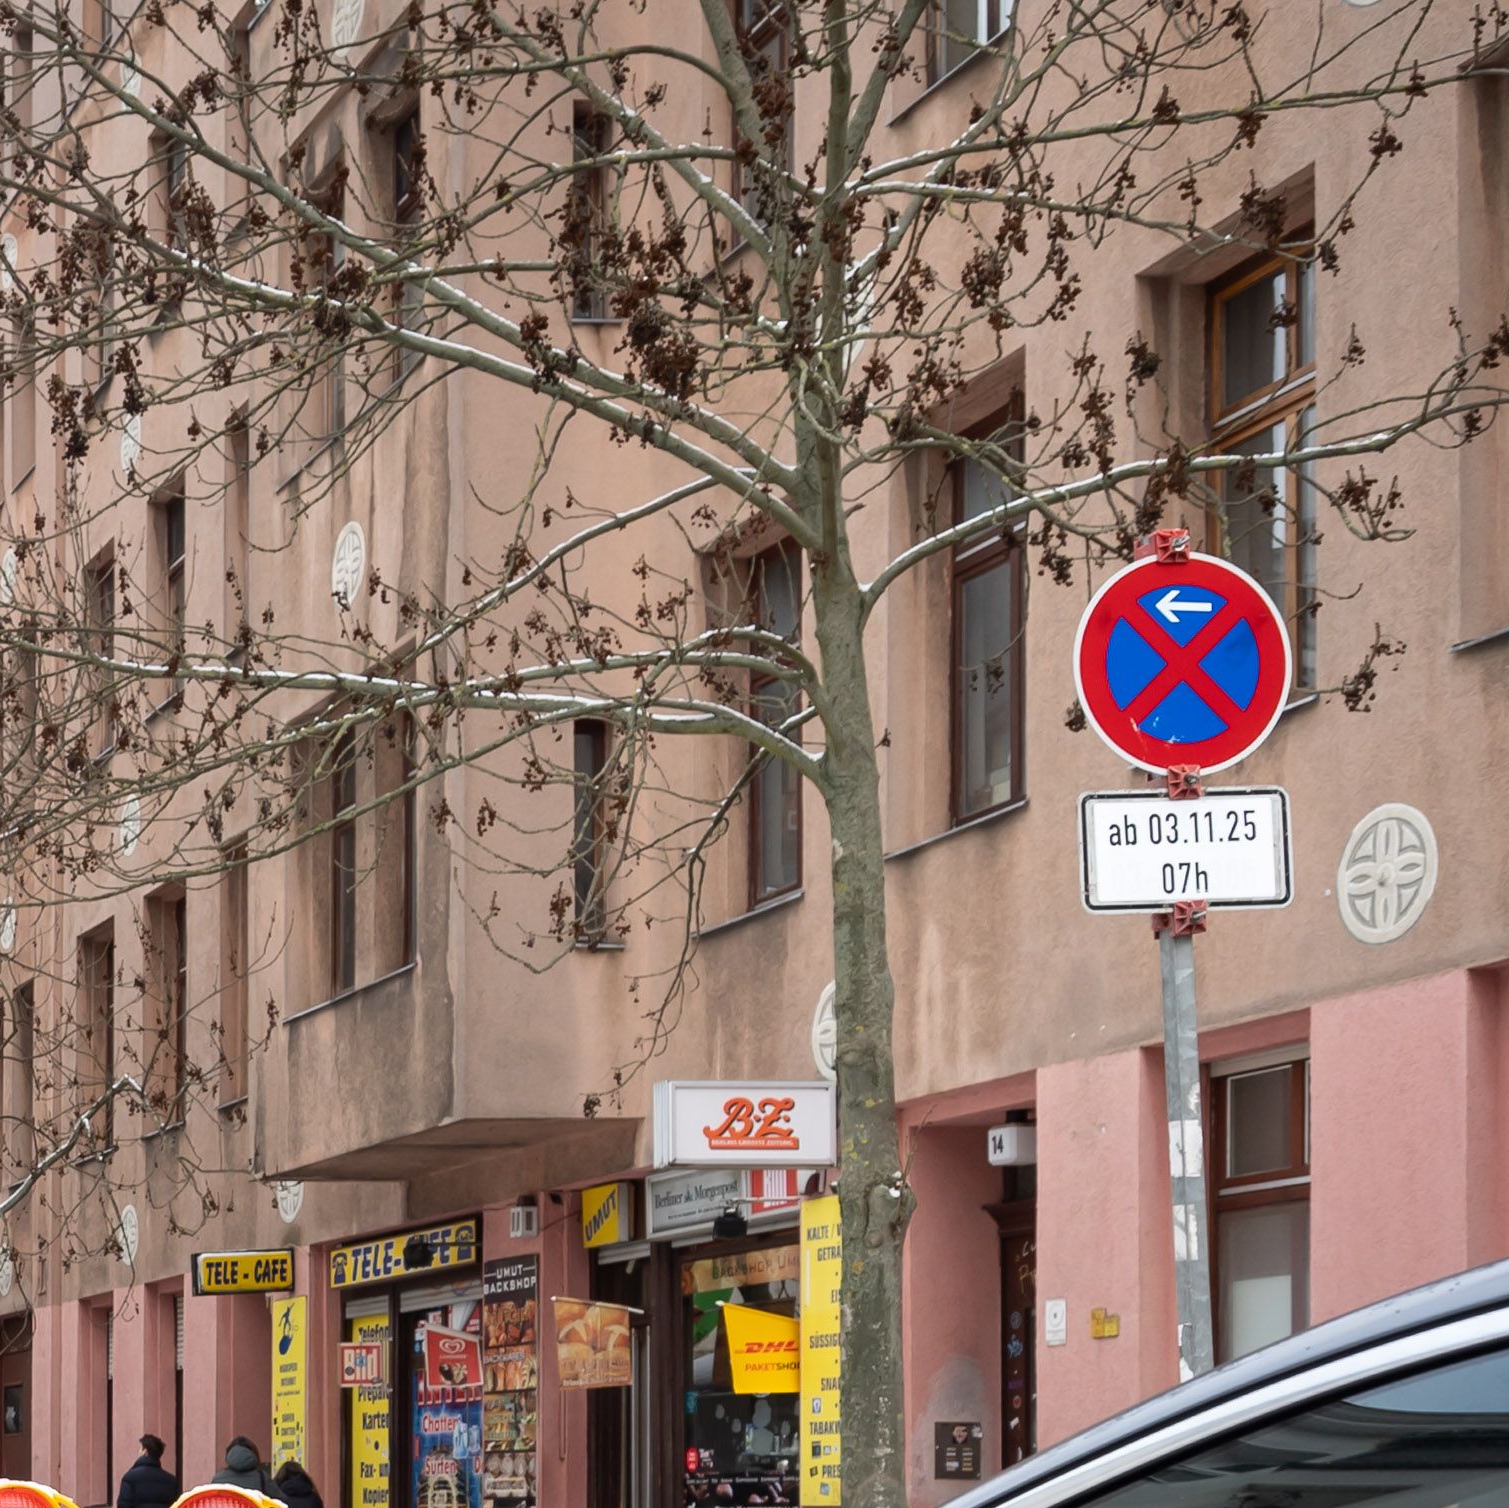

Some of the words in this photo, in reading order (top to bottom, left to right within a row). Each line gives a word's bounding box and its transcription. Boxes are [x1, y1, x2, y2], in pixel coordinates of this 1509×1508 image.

[1109, 815, 1138, 847] ab
[1148, 810, 1257, 845] 03.11.25
[1162, 861, 1210, 894] 07h
[991, 1135, 1004, 1154] 14
[654, 1189, 684, 1210] Berliner
[694, 1180, 738, 1202] Morgenpost
[585, 1189, 617, 1241] UMUT
[806, 1225, 830, 1242] KALTE
[206, 1261, 239, 1286] TELE
[254, 1258, 288, 1284] CAFE
[483, 1275, 537, 1296] BACKSHOP
[496, 1264, 524, 1279] UMUT
[744, 1340, 799, 1354] DHL
[343, 1348, 379, 1380] Bild
